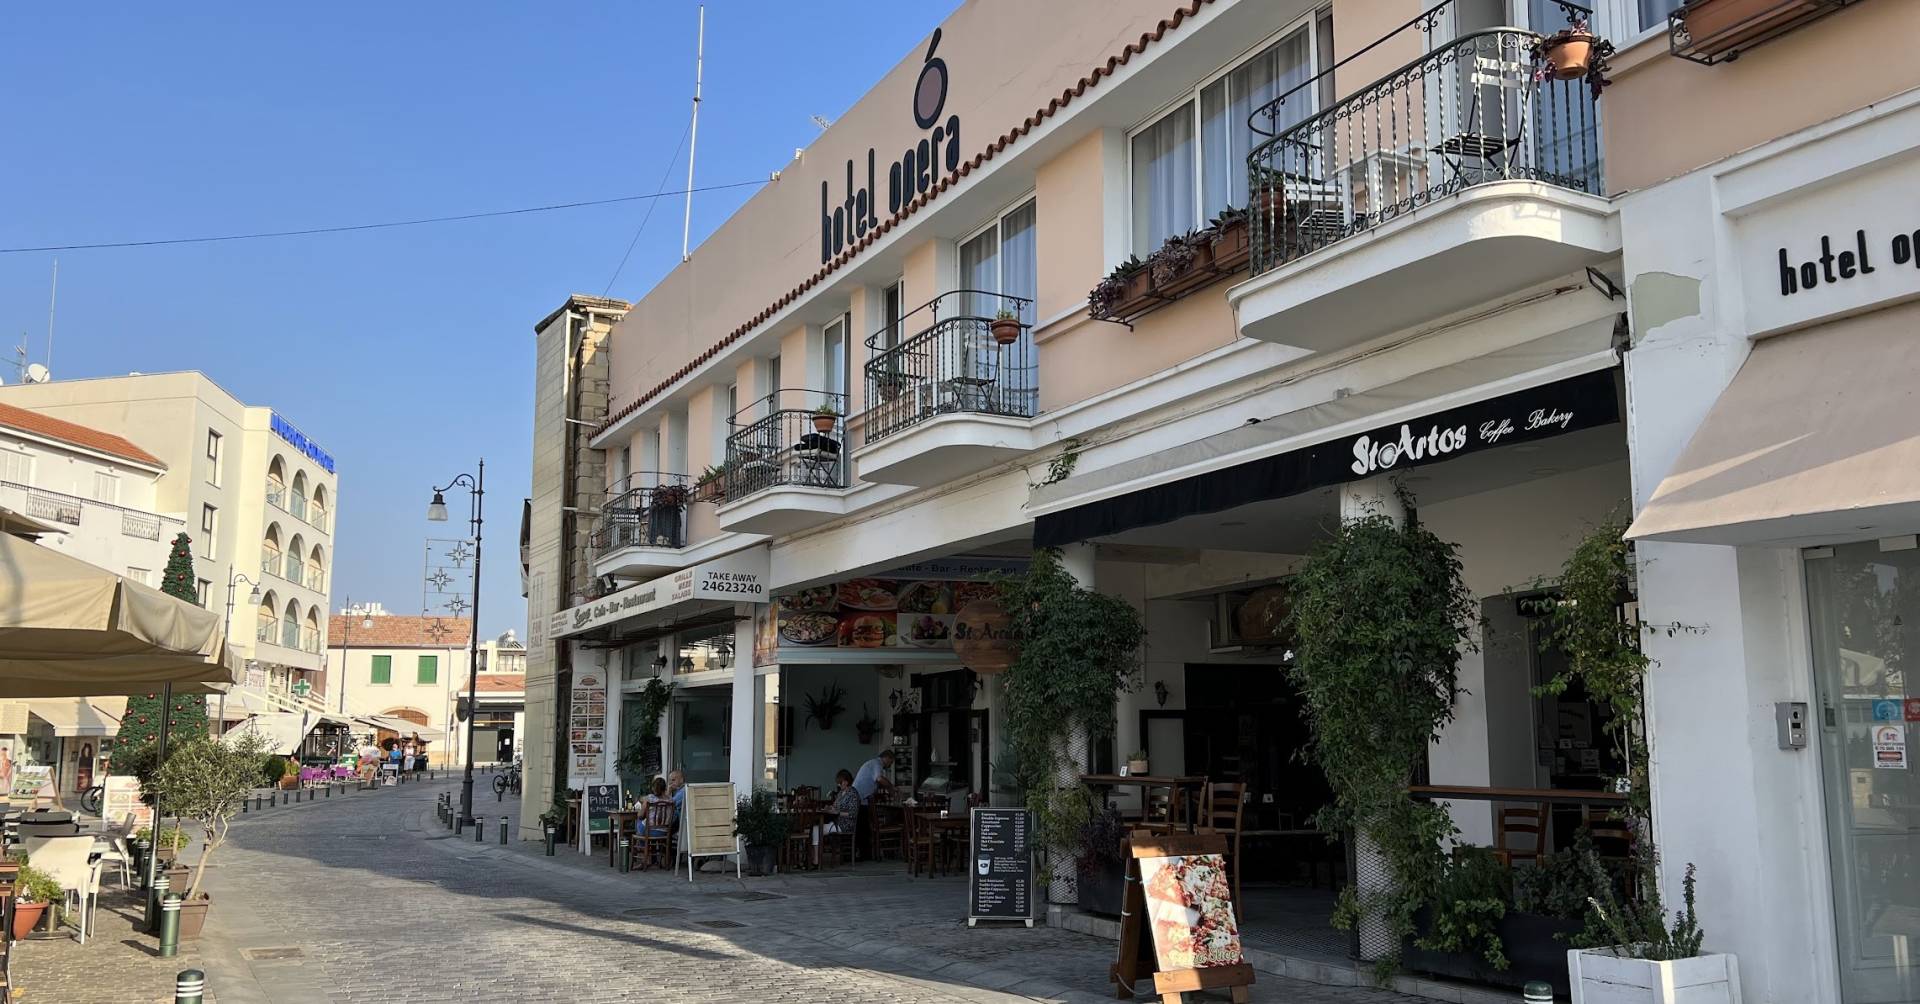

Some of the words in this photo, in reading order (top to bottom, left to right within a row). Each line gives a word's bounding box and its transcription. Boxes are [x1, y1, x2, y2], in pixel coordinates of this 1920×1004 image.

[821, 147, 878, 265] hotel
[889, 114, 960, 214] opera
[1778, 229, 1876, 297] hotel
[1479, 417, 1515, 444] Coffee
[1524, 407, 1574, 432] Bakery
[702, 580, 762, 594] 24623240
[708, 571, 731, 581] TAKE
[732, 573, 757, 583] AWAY
